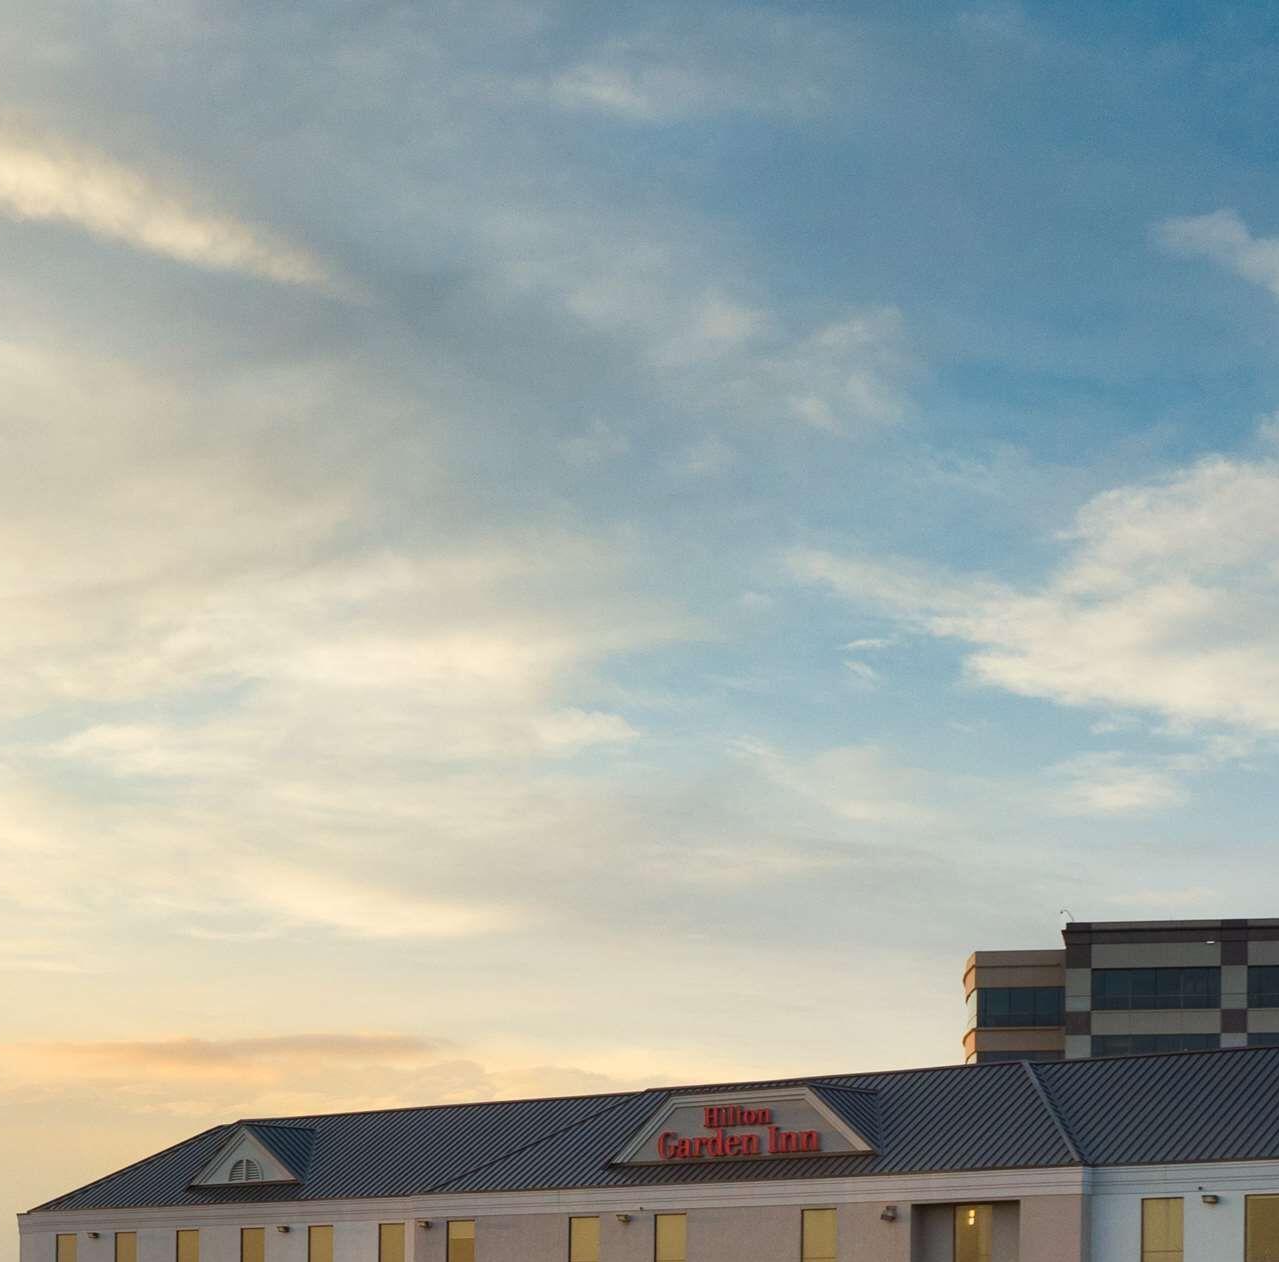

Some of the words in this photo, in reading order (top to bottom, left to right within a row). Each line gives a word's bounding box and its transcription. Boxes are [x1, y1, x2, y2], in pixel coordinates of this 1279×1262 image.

[703, 1104, 772, 1128] Hilton
[657, 1126, 760, 1160] Garden
[768, 1126, 819, 1153] Inn
